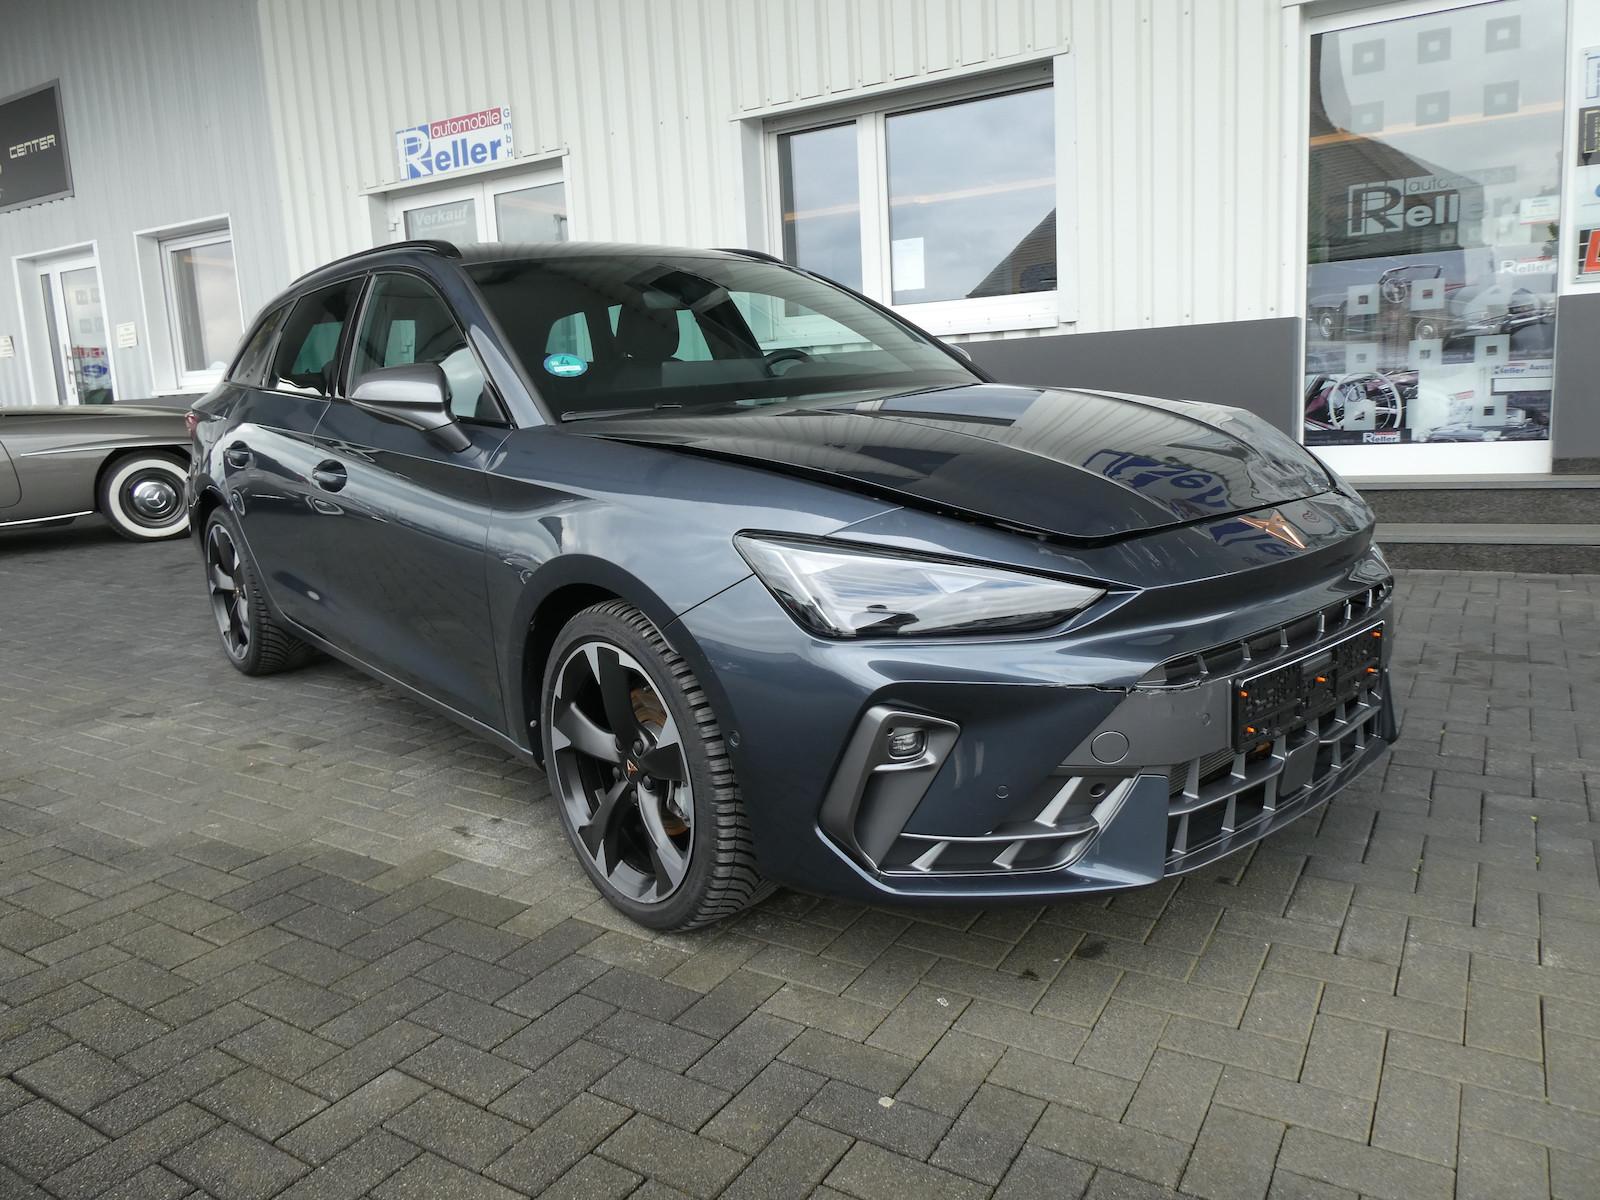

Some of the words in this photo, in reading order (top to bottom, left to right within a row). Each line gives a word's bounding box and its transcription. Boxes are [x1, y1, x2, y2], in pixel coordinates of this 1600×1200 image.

[432, 111, 501, 139] automobile
[9, 134, 56, 159] CENTER
[397, 127, 502, 180] Reller
[415, 204, 468, 226] Verkauf
